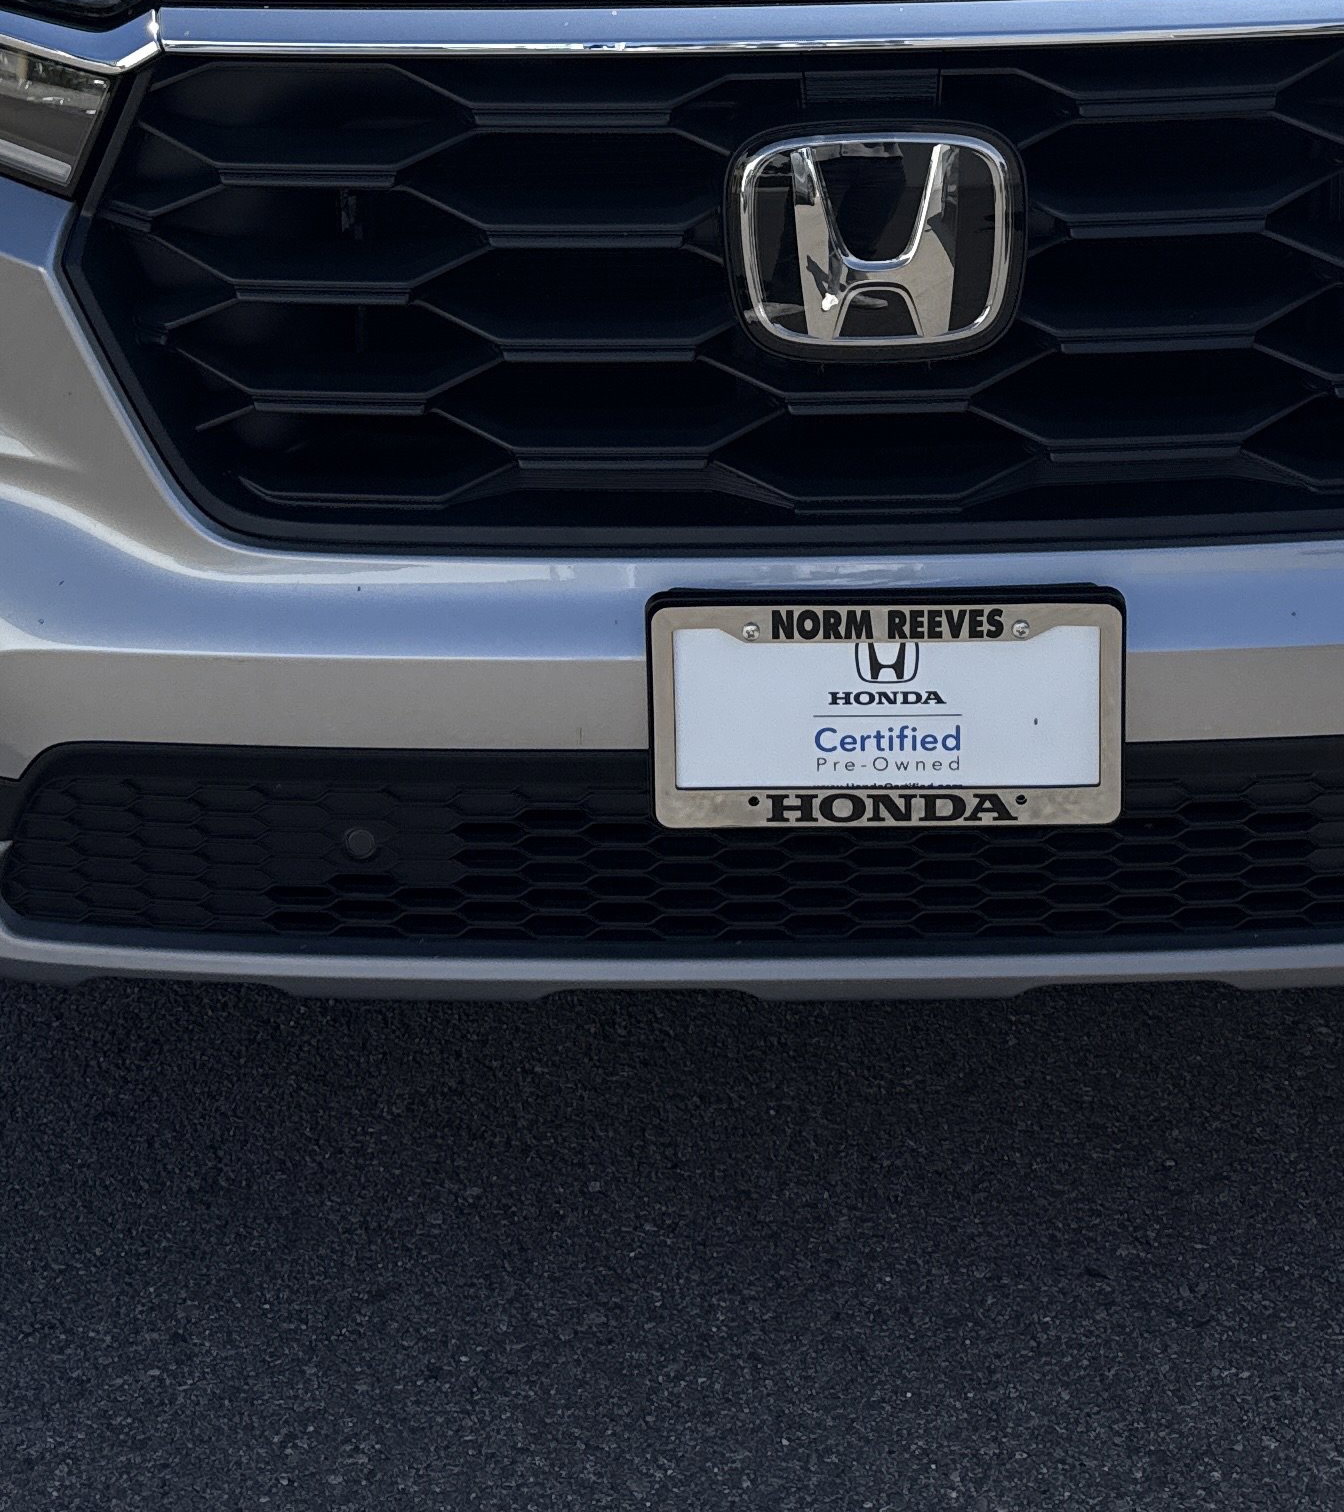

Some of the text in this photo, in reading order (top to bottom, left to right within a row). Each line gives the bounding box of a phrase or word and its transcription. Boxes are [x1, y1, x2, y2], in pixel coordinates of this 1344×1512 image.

[772, 608, 1004, 640] NORM REEVES
[827, 691, 947, 706] HONDA
[814, 724, 962, 753] Certified
[816, 756, 961, 772] Pre-Owned
[766, 793, 1019, 823] HONDA
